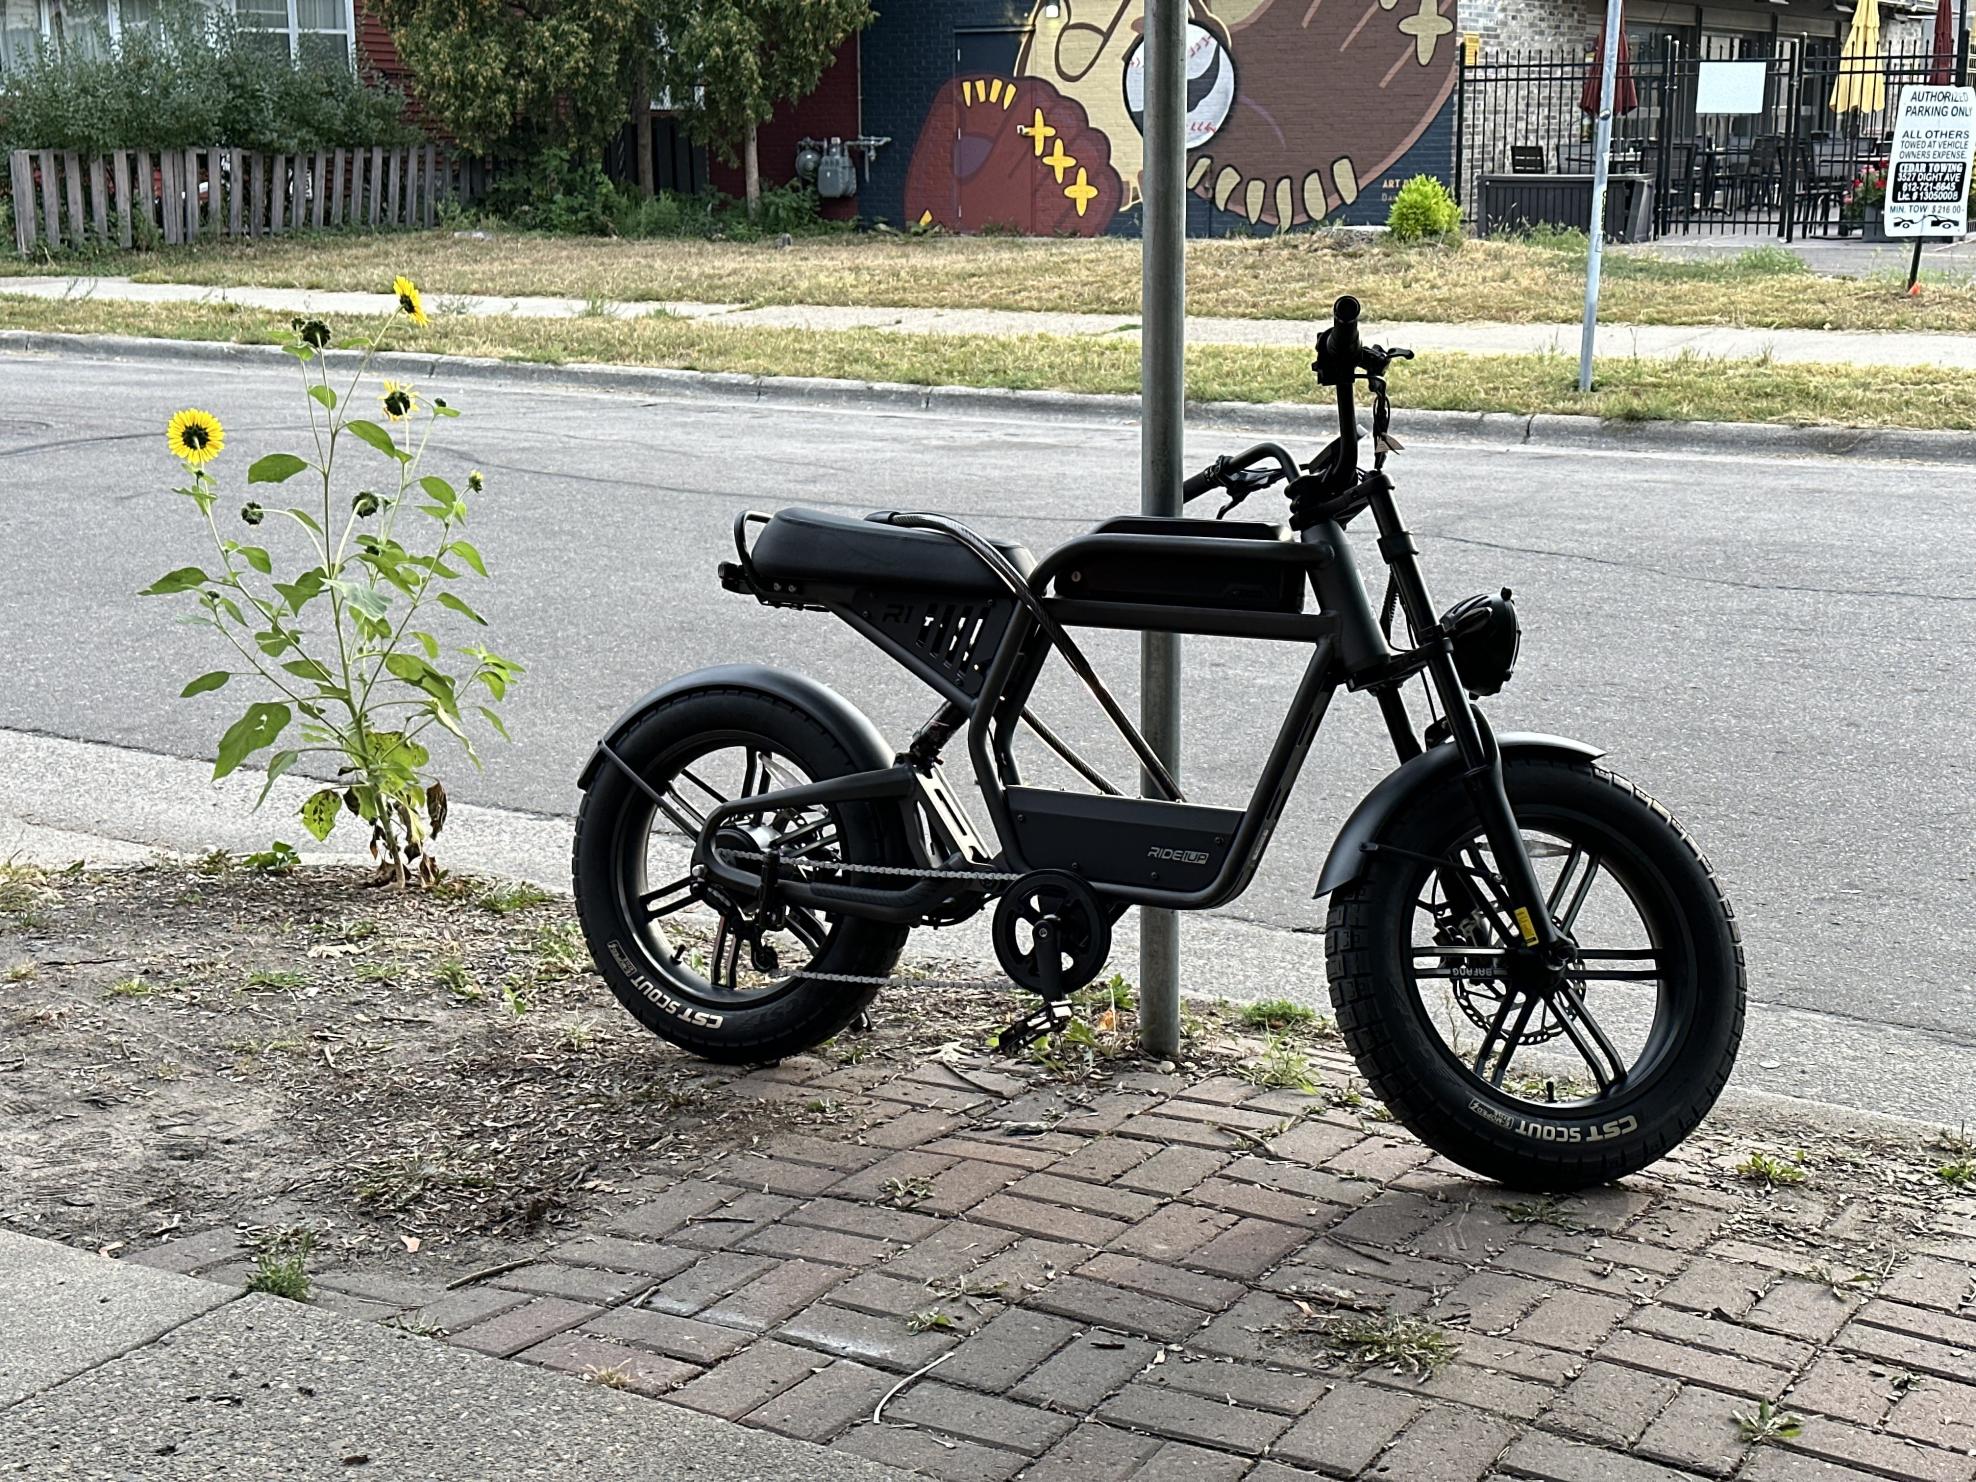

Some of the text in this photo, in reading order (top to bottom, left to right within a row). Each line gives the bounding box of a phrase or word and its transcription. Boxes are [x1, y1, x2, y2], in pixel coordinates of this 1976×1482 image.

[1905, 106, 1972, 117] PARKING ONLY
[1902, 130, 1970, 139] ALL OTHERS
[1901, 141, 1969, 150] TOWED AT VEHICLE
[1899, 151, 1931, 159] OWNERS
[1899, 163, 1963, 173] CEDAR TOWING
[1897, 173, 1962, 182] 3527 DIGHT AVE
[1909, 205, 1928, 213] TOW
[630, 975, 724, 1029] CST SCOUT
[1515, 1120, 1581, 1143] SCOUT
[1586, 1114, 1638, 1142] CST
